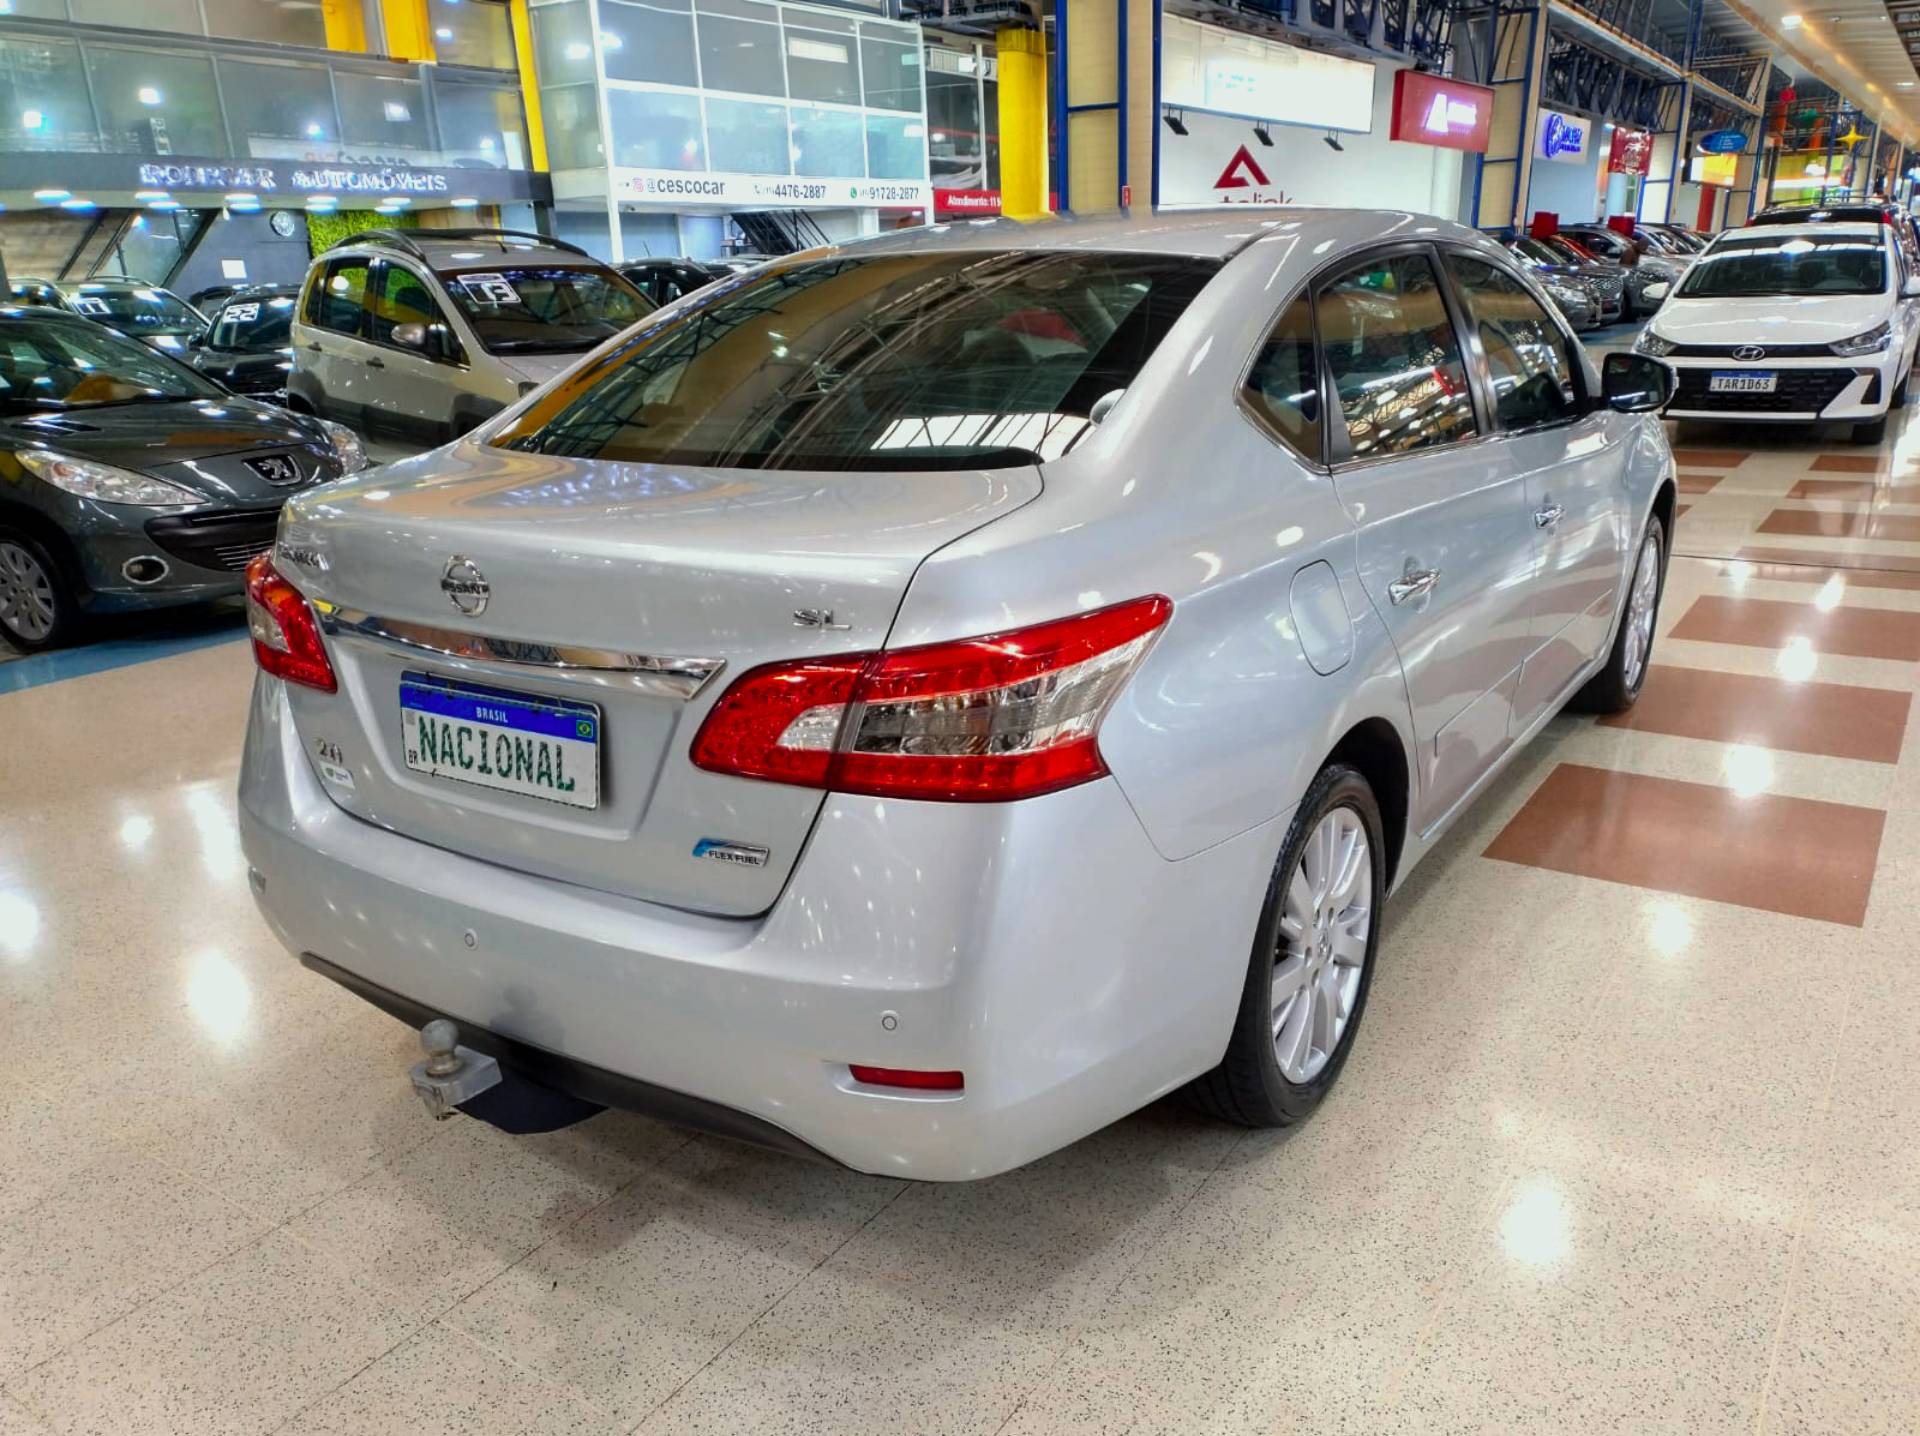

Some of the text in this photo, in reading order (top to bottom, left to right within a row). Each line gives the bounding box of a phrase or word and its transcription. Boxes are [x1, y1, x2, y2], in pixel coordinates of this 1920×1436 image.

[475, 706, 509, 724] BRASIL
[408, 749, 419, 765] BR
[418, 715, 576, 792] NACIONAL
